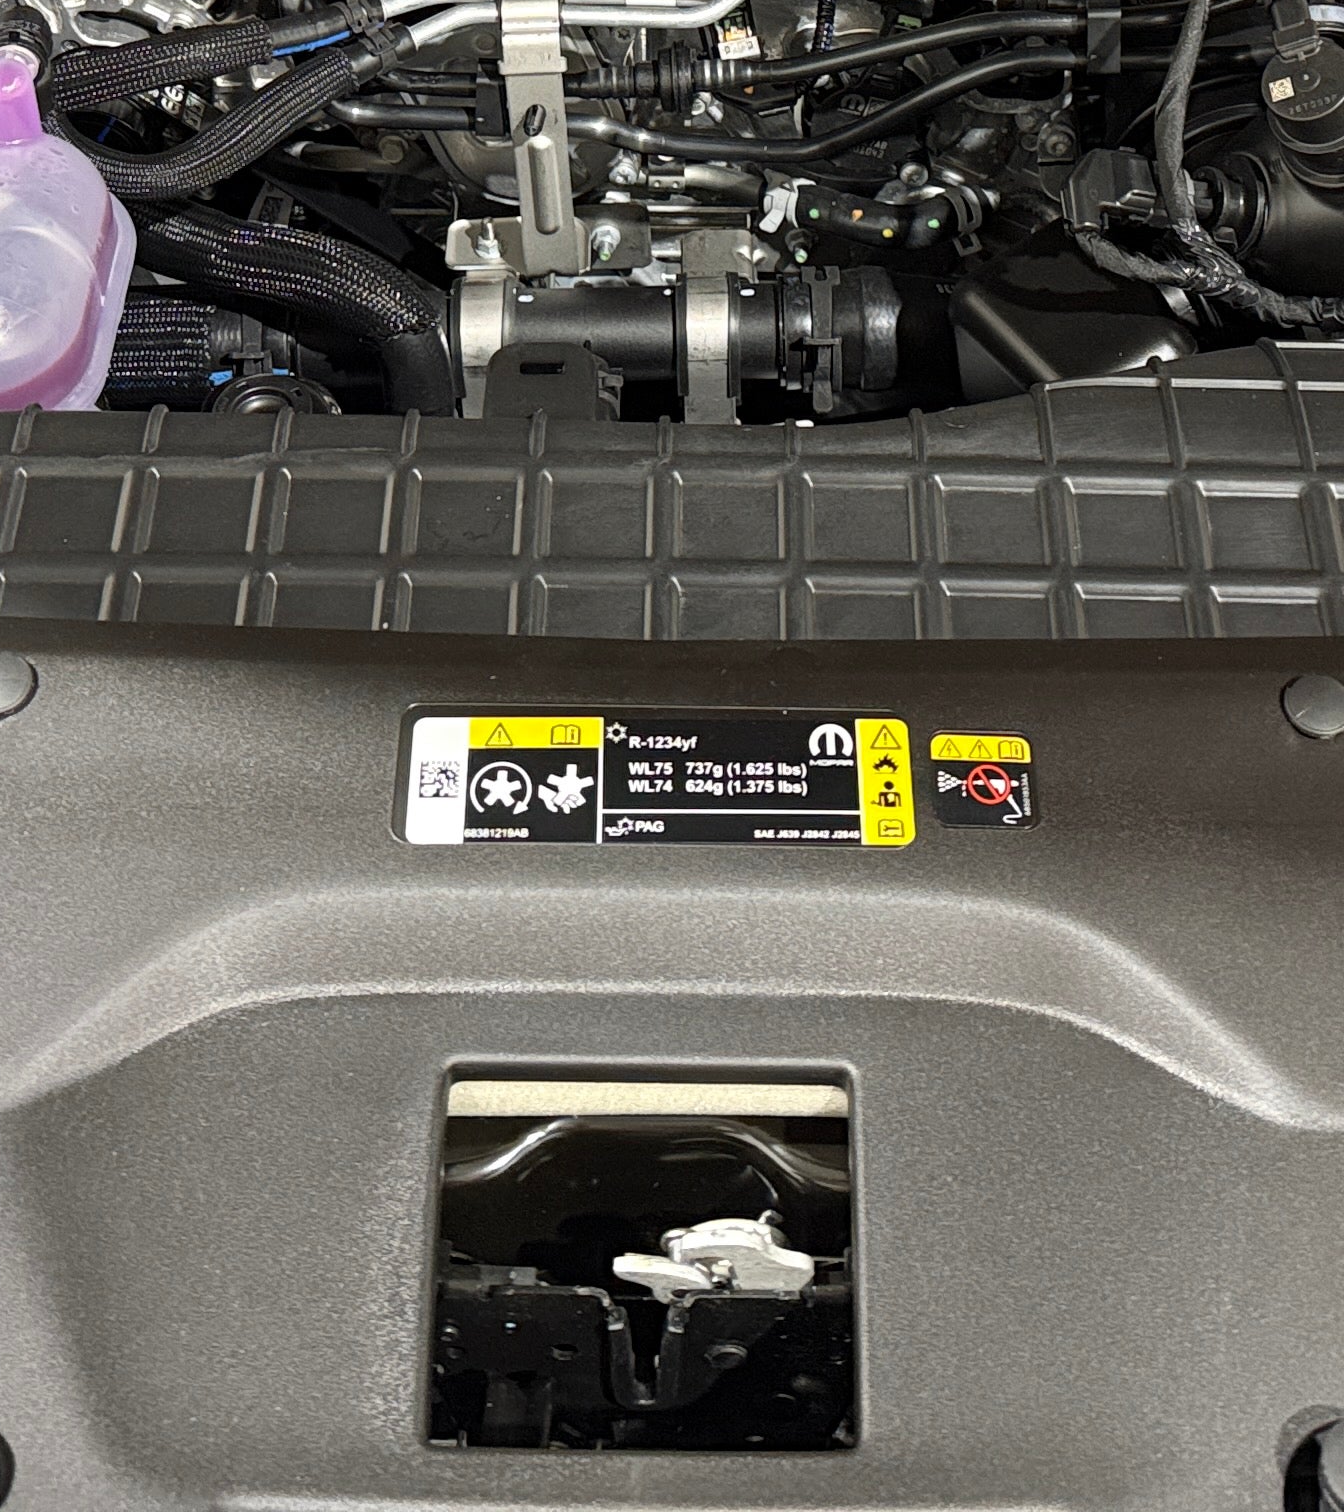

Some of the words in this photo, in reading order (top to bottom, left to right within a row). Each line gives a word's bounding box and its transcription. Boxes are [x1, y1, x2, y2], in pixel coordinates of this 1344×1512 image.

[628, 735, 698, 753] R-1234yf
[628, 761, 673, 776] WL75
[685, 762, 724, 778] 737g
[726, 762, 774, 778] (1.625
[777, 762, 808, 778] lbs)
[628, 779, 673, 793] WL74
[685, 779, 724, 795] 624g
[726, 779, 774, 796] (1.375
[777, 779, 809, 796] lbs)
[635, 820, 665, 834] PAG
[753, 829, 775, 839] SAE
